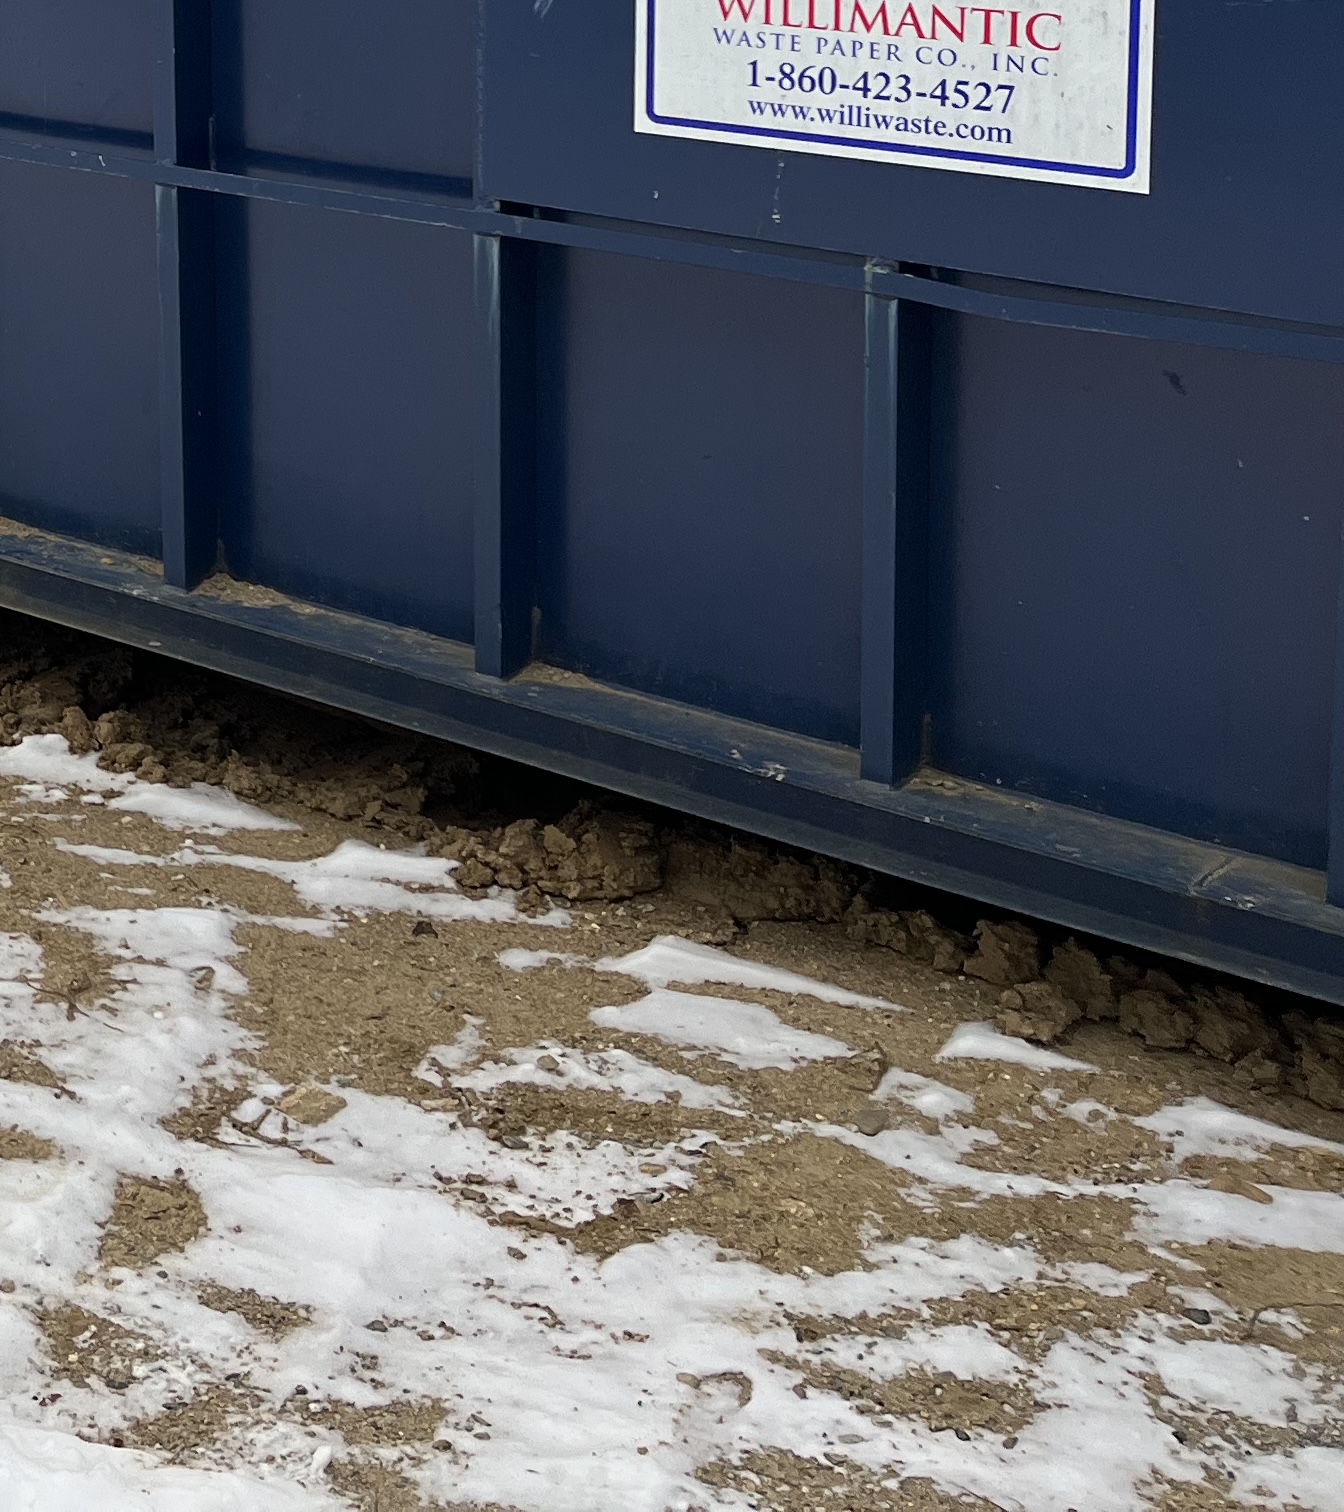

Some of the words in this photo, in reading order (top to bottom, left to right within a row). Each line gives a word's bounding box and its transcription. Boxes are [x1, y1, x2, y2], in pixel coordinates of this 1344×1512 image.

[712, 27, 802, 53] WASTE
[814, 36, 900, 62] PAPER
[991, 52, 1059, 77] INC.
[746, 59, 1016, 115] 1-860-423-4527
[747, 97, 1014, 144] www.williwaste.com
